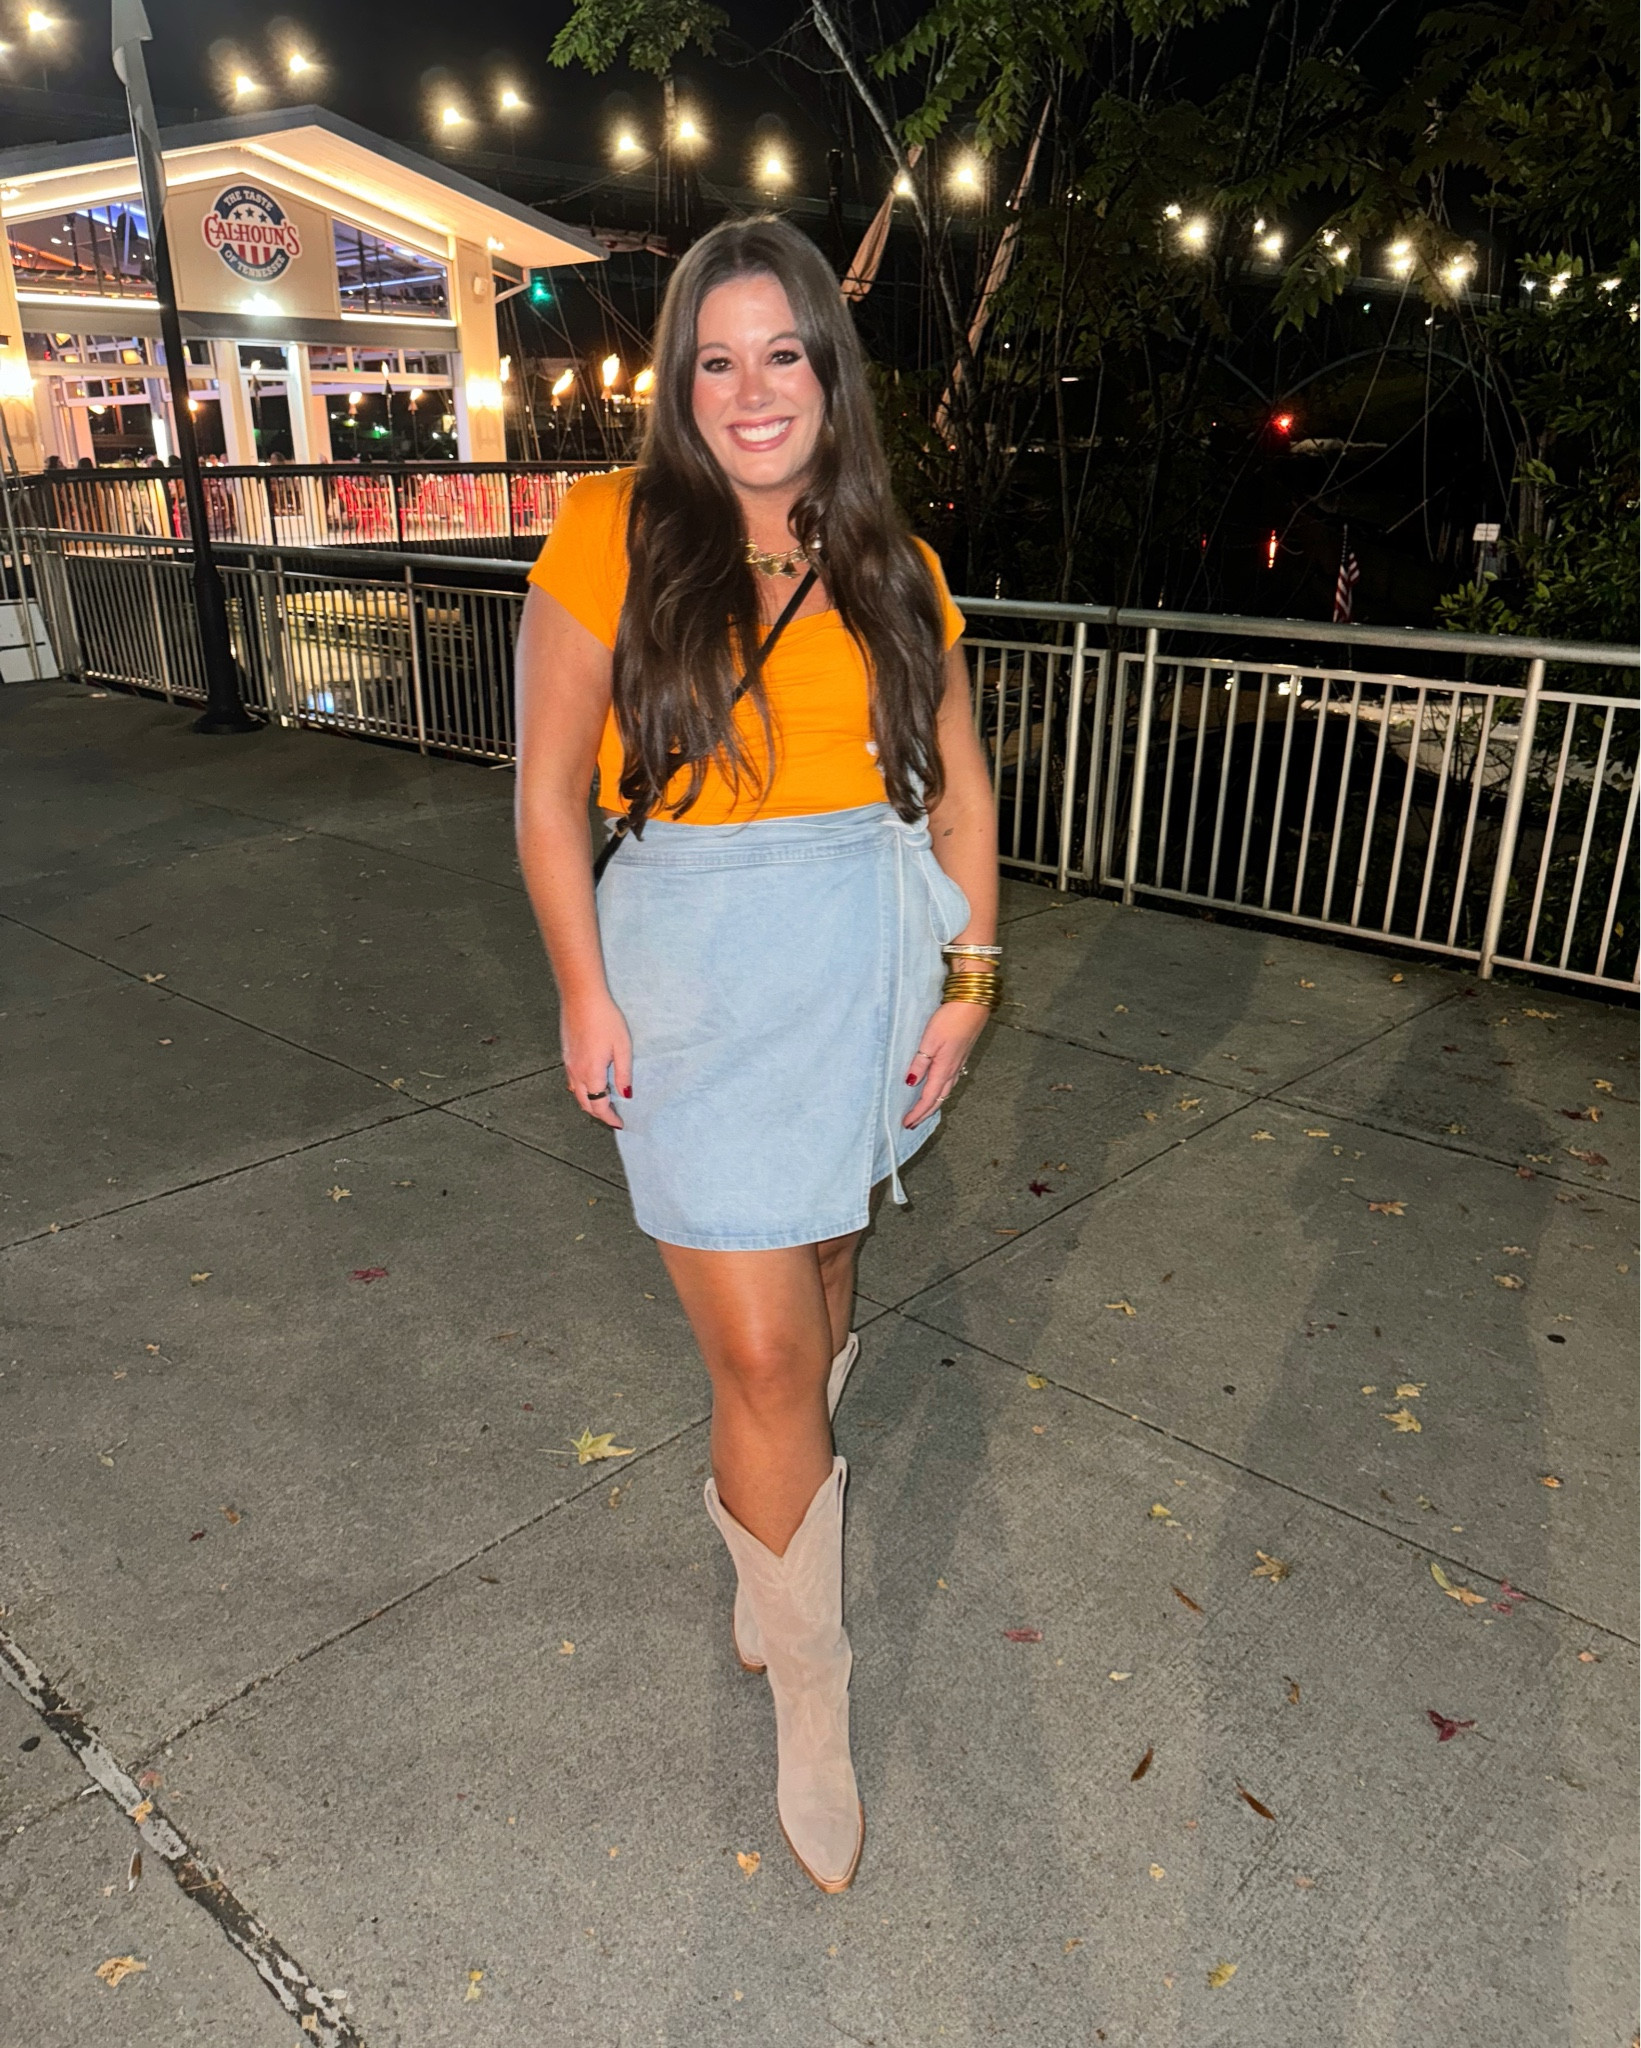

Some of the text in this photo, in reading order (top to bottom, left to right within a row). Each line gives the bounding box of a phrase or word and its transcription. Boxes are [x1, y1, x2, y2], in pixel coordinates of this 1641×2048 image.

[223, 190, 273, 211] THE TASTE
[204, 213, 300, 256] CALHOUN'S
[224, 249, 285, 277] OF TENNESSEE
